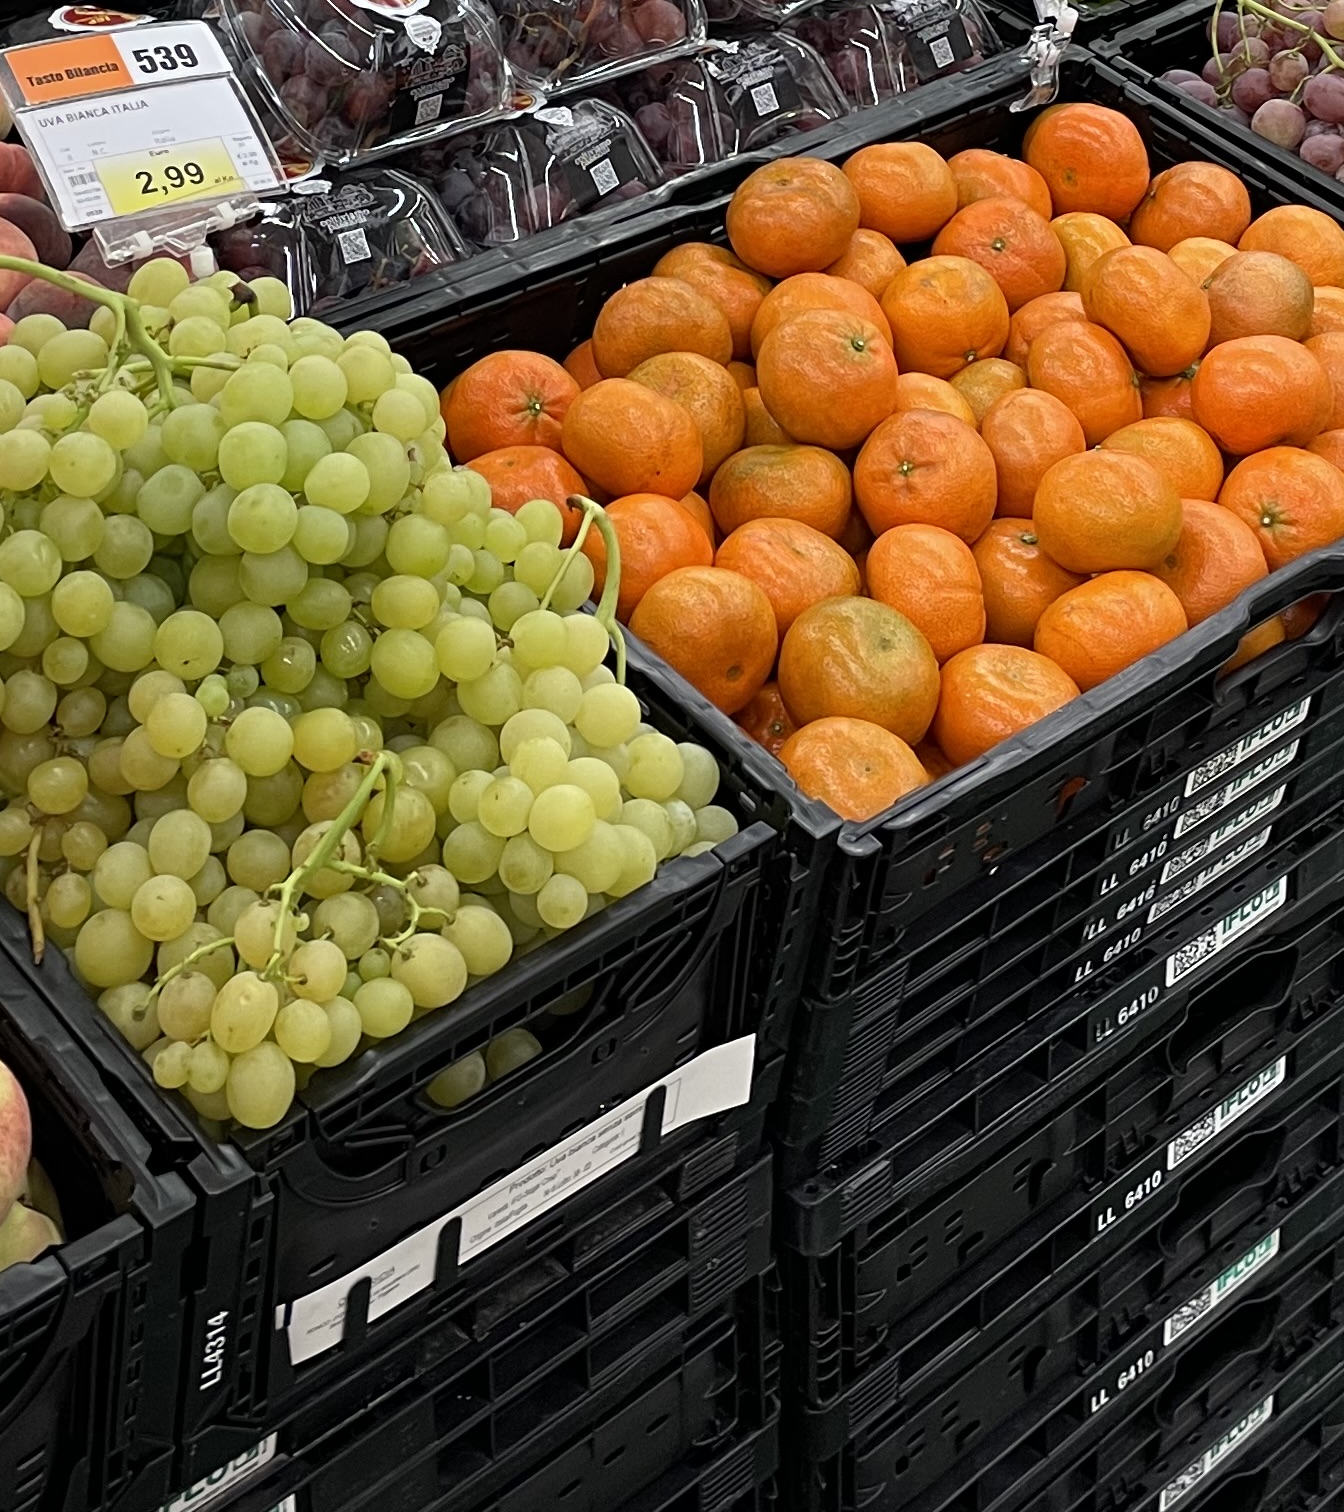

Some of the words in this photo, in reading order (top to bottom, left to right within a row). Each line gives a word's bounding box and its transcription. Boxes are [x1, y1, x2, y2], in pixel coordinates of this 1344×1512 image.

[27, 72, 64, 88] Tasto
[65, 62, 119, 80] Bilancia
[132, 44, 198, 74] 539
[38, 116, 64, 128] UVA
[66, 108, 108, 122] BIANCA
[111, 100, 149, 114] ITALIA
[136, 162, 204, 196] 2,99
[1100, 874, 1119, 895] LL
[1129, 841, 1168, 876] 6410
[1075, 961, 1093, 982] LL
[1104, 927, 1142, 962] 6410
[1096, 1019, 1113, 1042] LL
[1117, 987, 1158, 1025] 6410
[1097, 1207, 1116, 1231] LL
[1125, 1170, 1162, 1209] 6410
[199, 1310, 229, 1390] LL4314
[1091, 1389, 1110, 1413] LL
[1118, 1350, 1154, 1391] 6410
